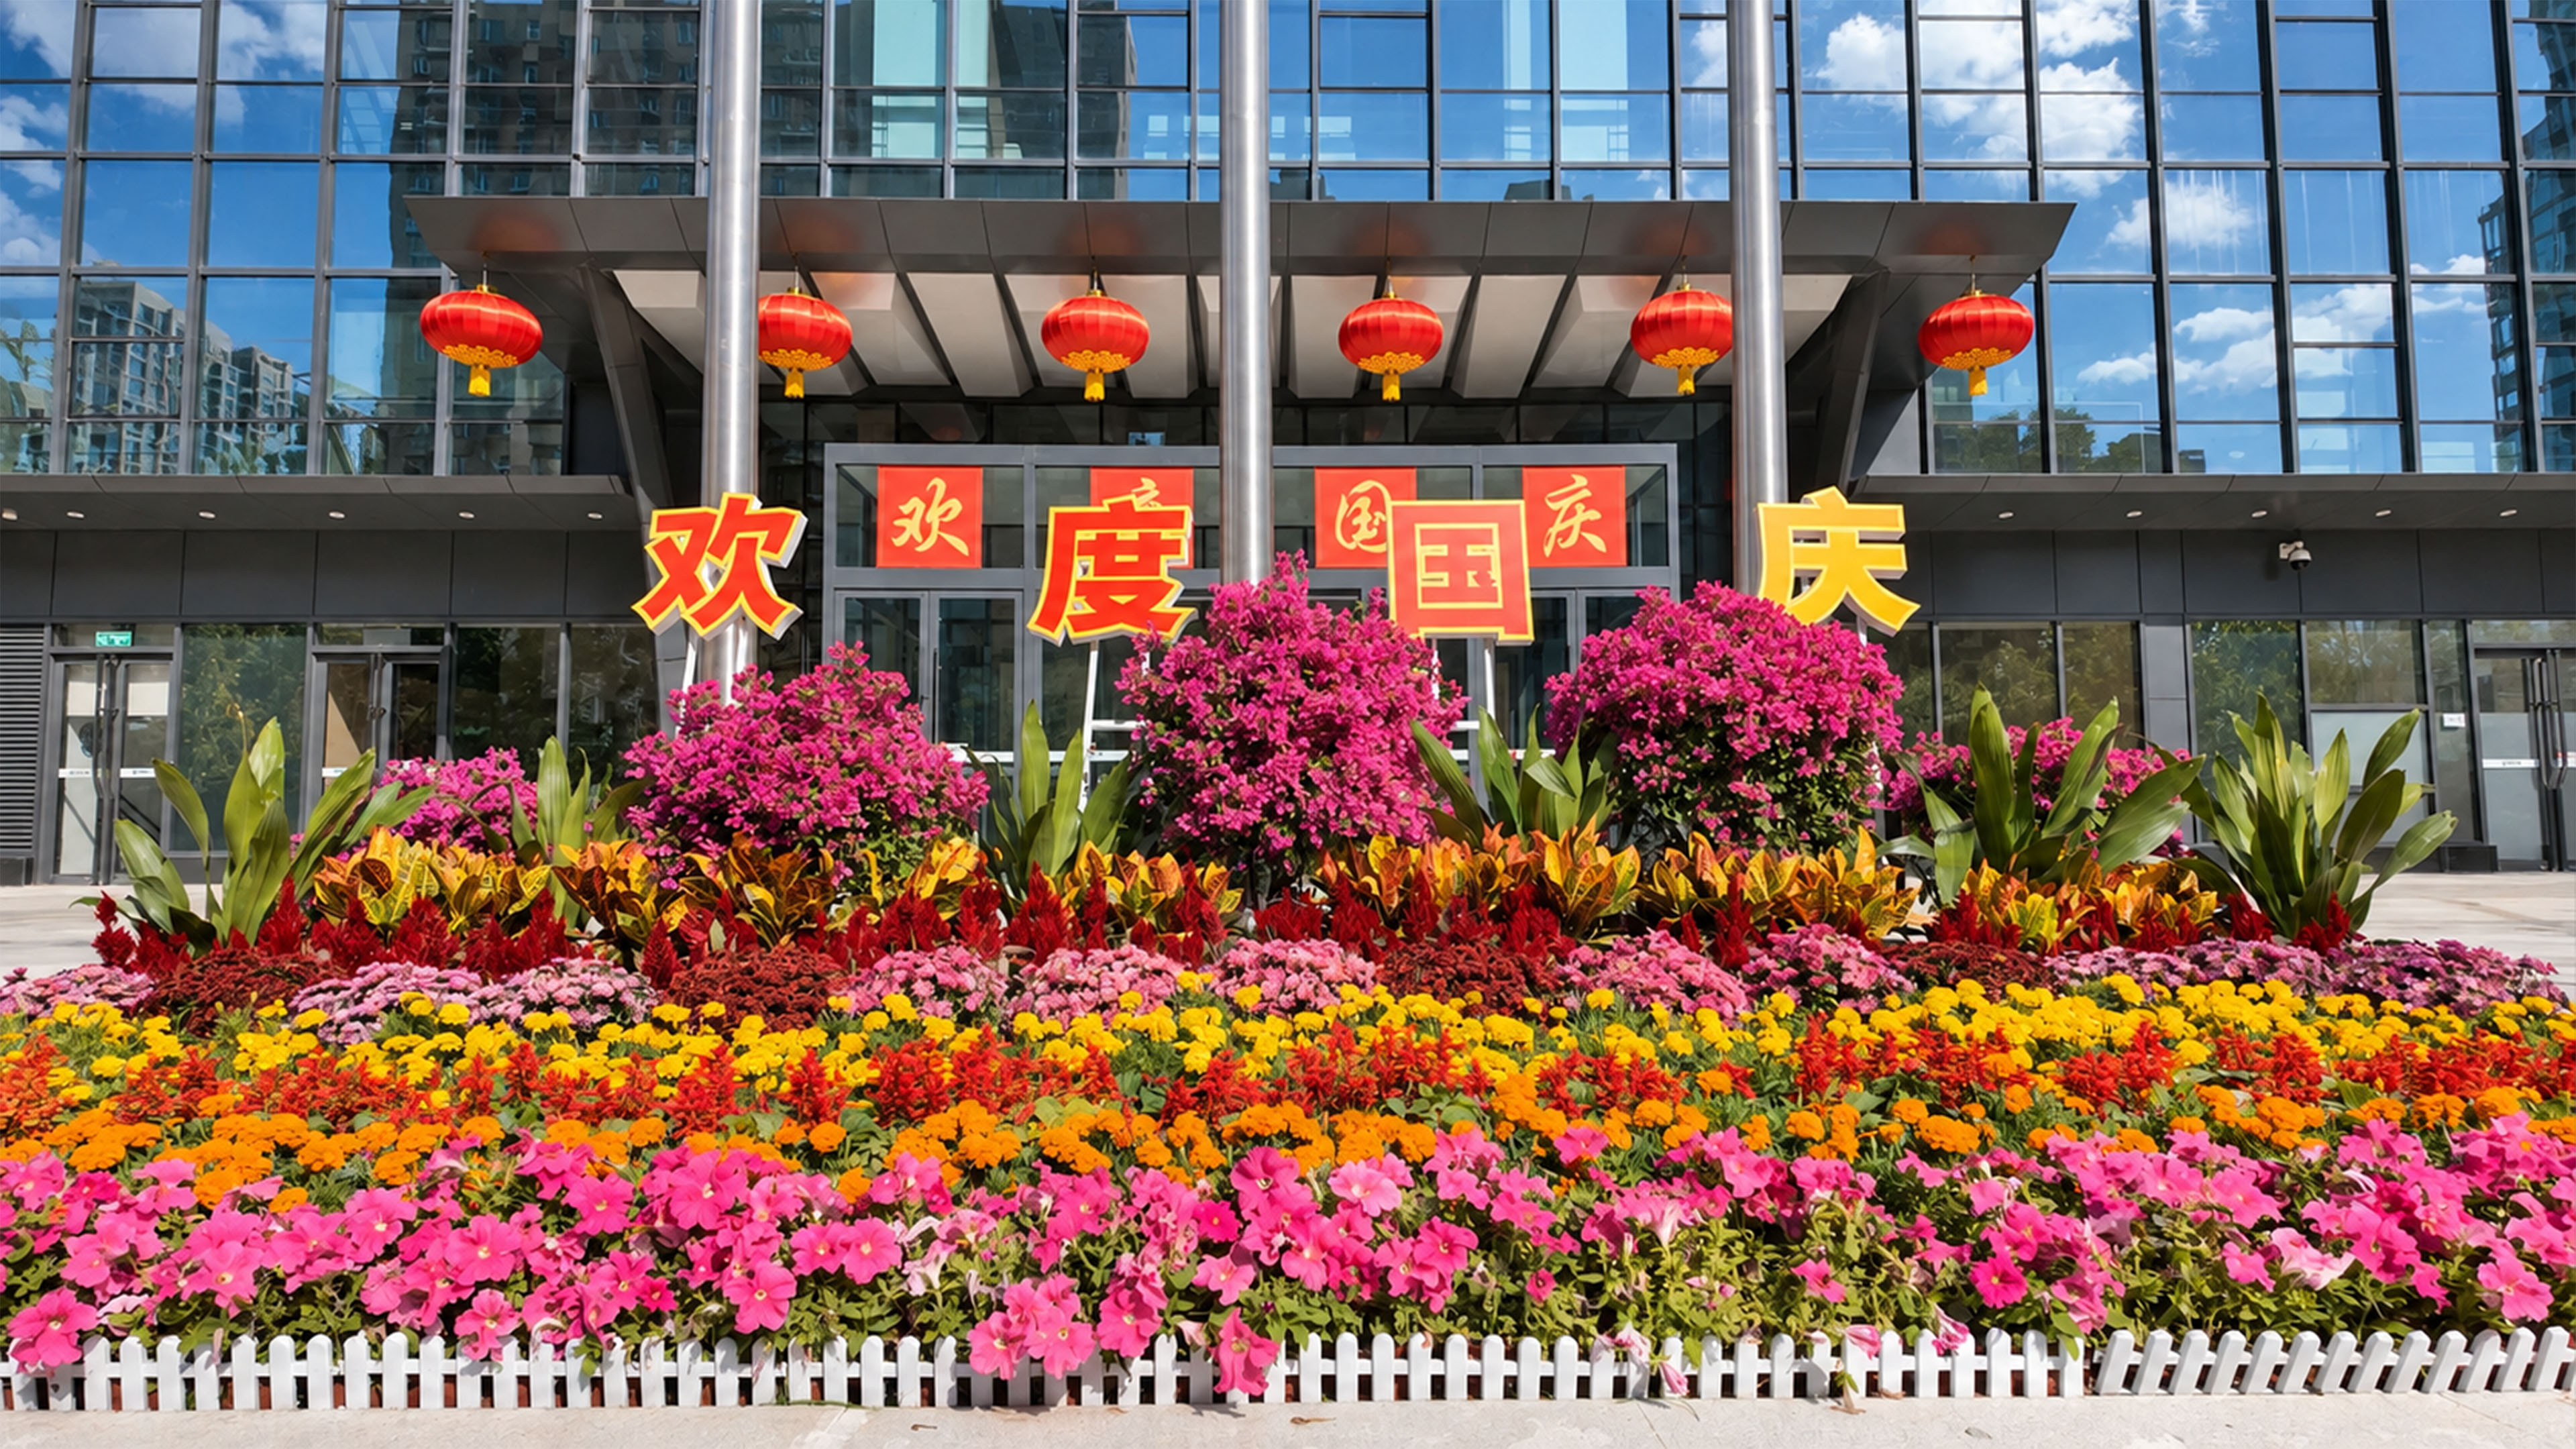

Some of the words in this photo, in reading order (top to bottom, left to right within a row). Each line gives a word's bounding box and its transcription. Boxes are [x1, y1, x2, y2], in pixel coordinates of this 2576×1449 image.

[631, 492, 805, 639] 欢
[1028, 494, 1197, 644] 度
[1387, 500, 1535, 645] 国
[1757, 486, 1921, 634] 庆
[892, 477, 969, 556] 欢
[1335, 480, 1387, 553] 国
[1544, 474, 1607, 557] 庆
